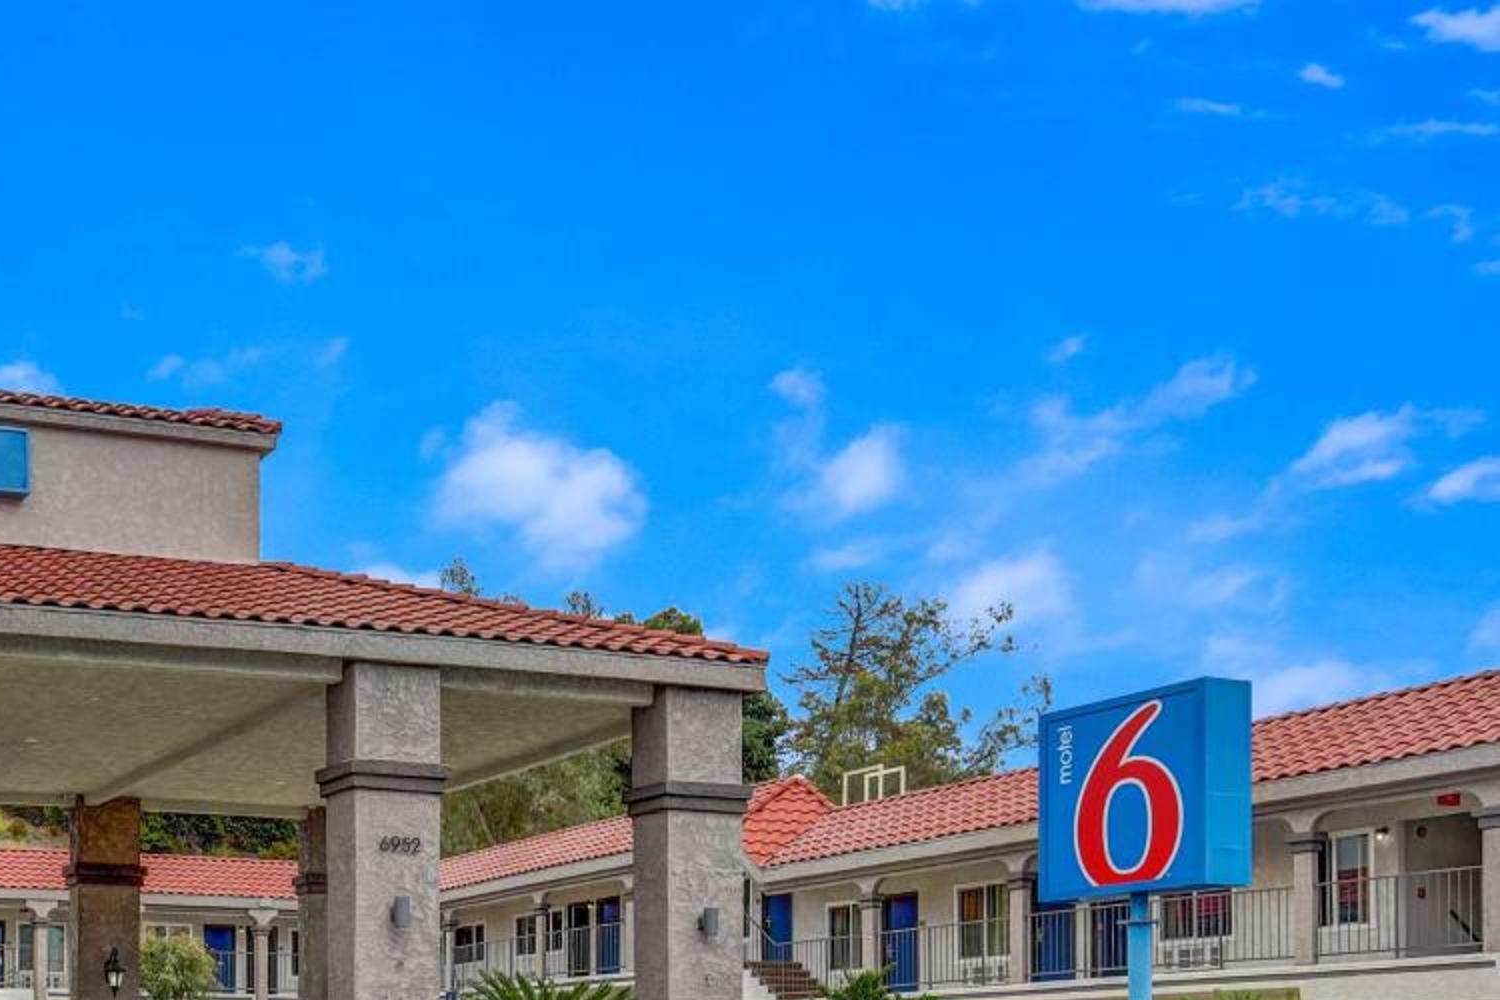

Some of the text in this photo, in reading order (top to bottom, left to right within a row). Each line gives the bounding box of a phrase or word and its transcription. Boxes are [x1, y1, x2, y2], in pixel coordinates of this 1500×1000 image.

[1057, 725, 1073, 784] motel
[1073, 698, 1185, 887] 6
[379, 835, 421, 856] 6952
